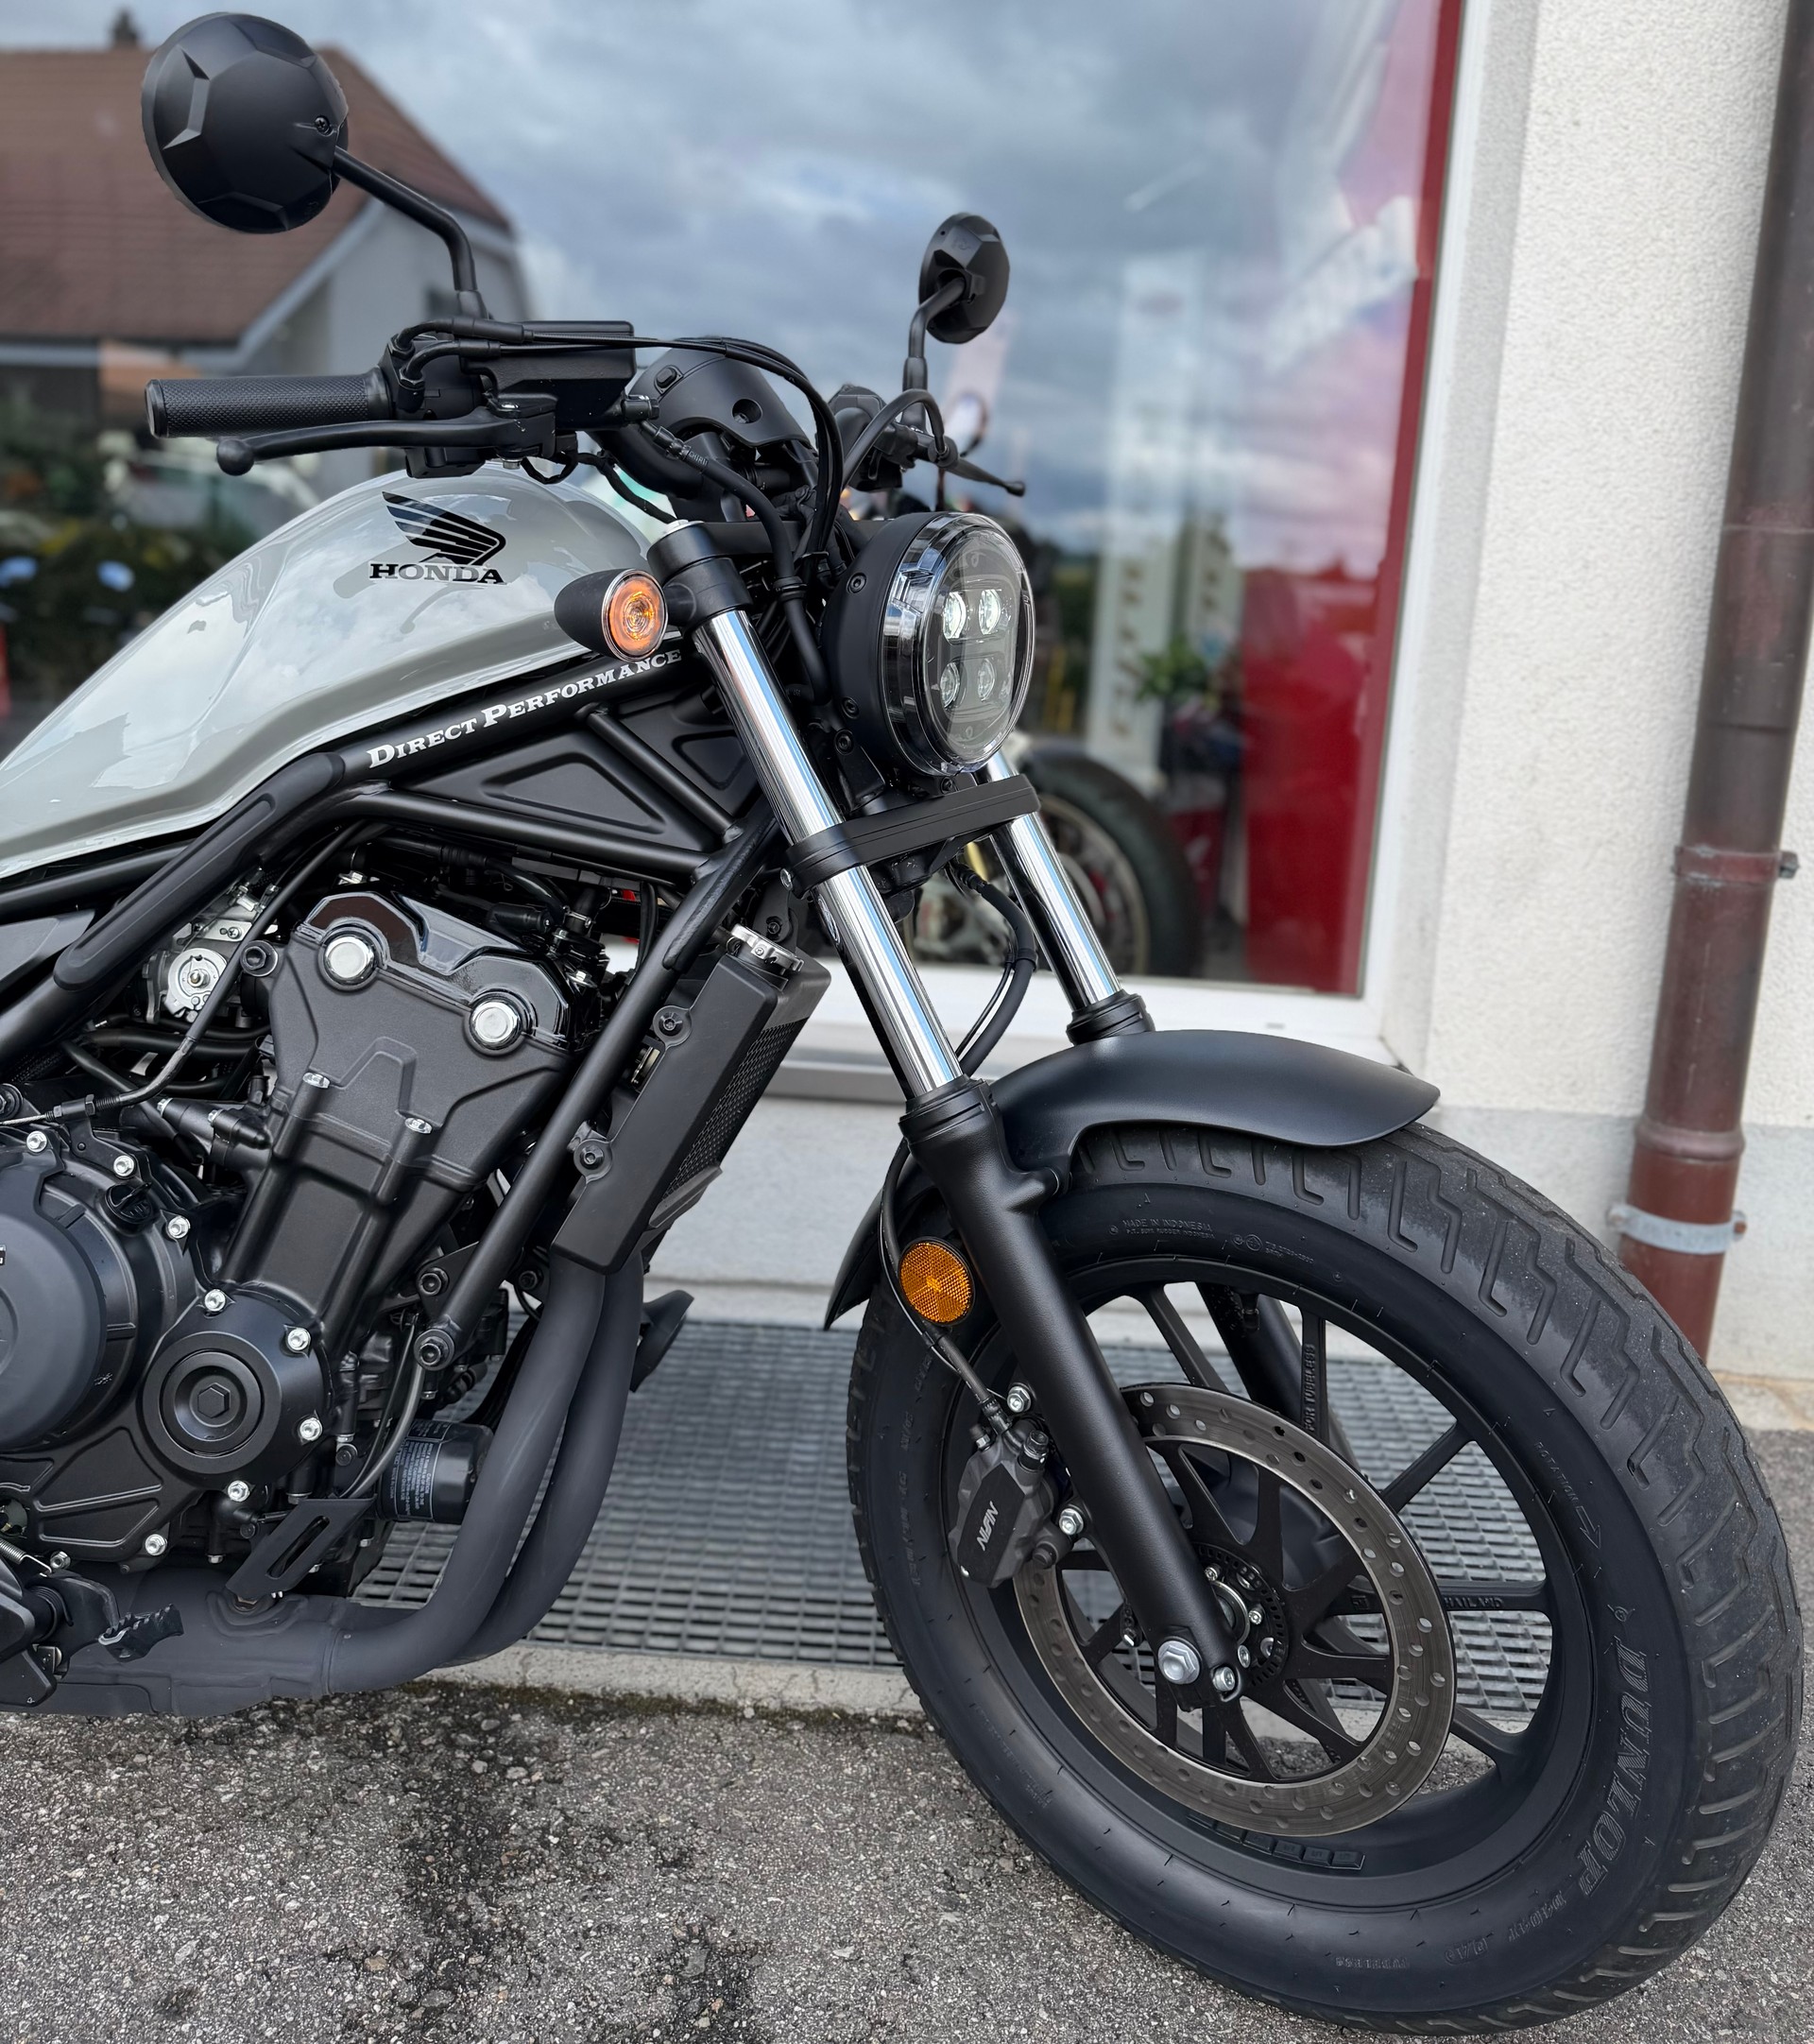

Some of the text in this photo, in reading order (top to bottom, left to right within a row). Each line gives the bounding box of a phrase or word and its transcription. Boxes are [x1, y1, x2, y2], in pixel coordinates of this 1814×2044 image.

[369, 563, 506, 585] HONDA
[366, 648, 682, 768] DIRECT PERFORMANCE
[1304, 1343, 1316, 1432] FOR TUBELESS
[1534, 1441, 1579, 1503] ROTATION
[1444, 1597, 1503, 1608] HAILAND
[1578, 1635, 1652, 1897] DUNLOP
